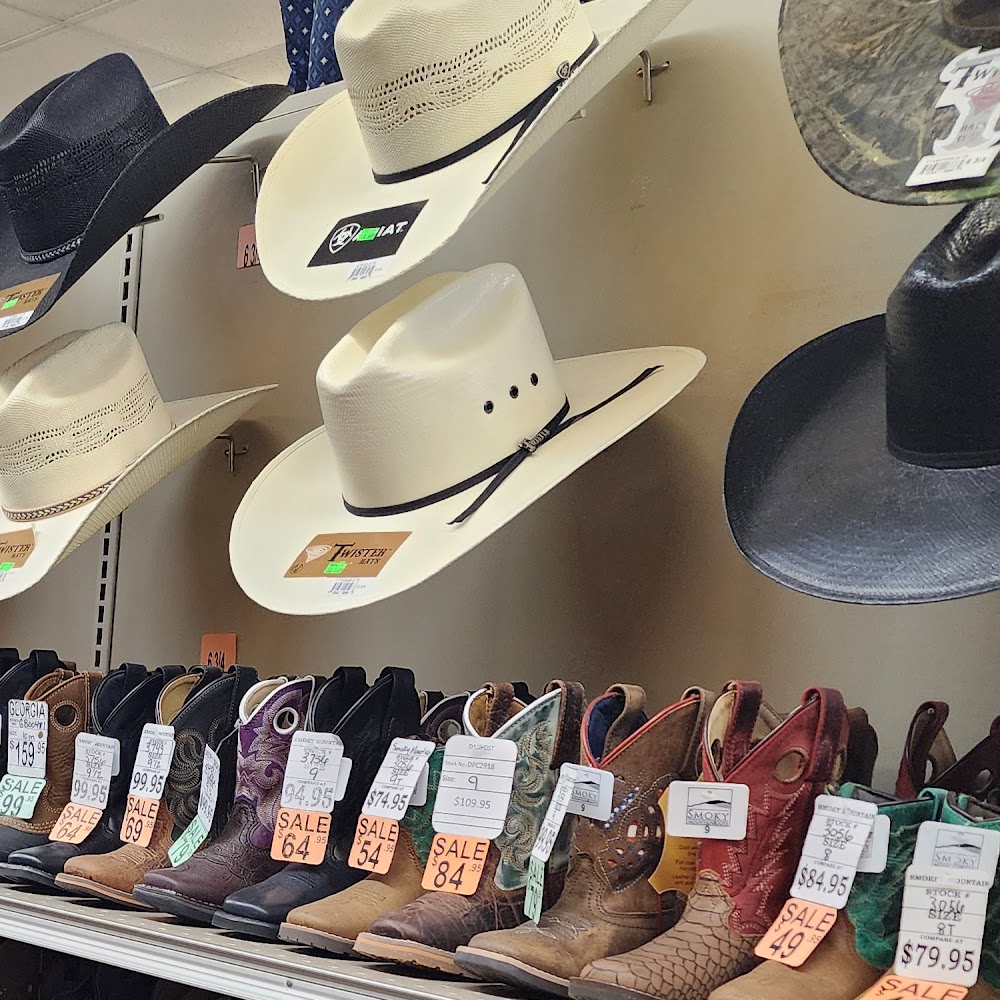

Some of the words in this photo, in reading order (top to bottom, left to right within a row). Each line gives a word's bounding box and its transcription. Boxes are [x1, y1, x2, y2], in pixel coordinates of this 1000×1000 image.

[328, 543, 388, 561] TWISTER
[9, 701, 46, 718] GEORGIA
[3, 778, 42, 795] SALE
[73, 779, 107, 803] 99.95
[132, 772, 165, 794] 99.95
[284, 783, 334, 809] 94.95
[367, 789, 409, 811] $74.95
[454, 797, 491, 809] $109.95
[61, 806, 102, 826] SALE
[128, 796, 158, 819] SALE
[278, 812, 329, 833] SALE
[358, 818, 398, 842] SALE
[826, 818, 852, 830] STOCK
[433, 837, 487, 862] SALE
[823, 837, 847, 850] SIZE
[797, 866, 849, 896] $84.95
[925, 889, 962, 898] STOCK
[781, 902, 835, 934] SALE
[928, 909, 962, 921] SIZE
[920, 935, 953, 944] COMPARE
[900, 942, 975, 973] $79.95
